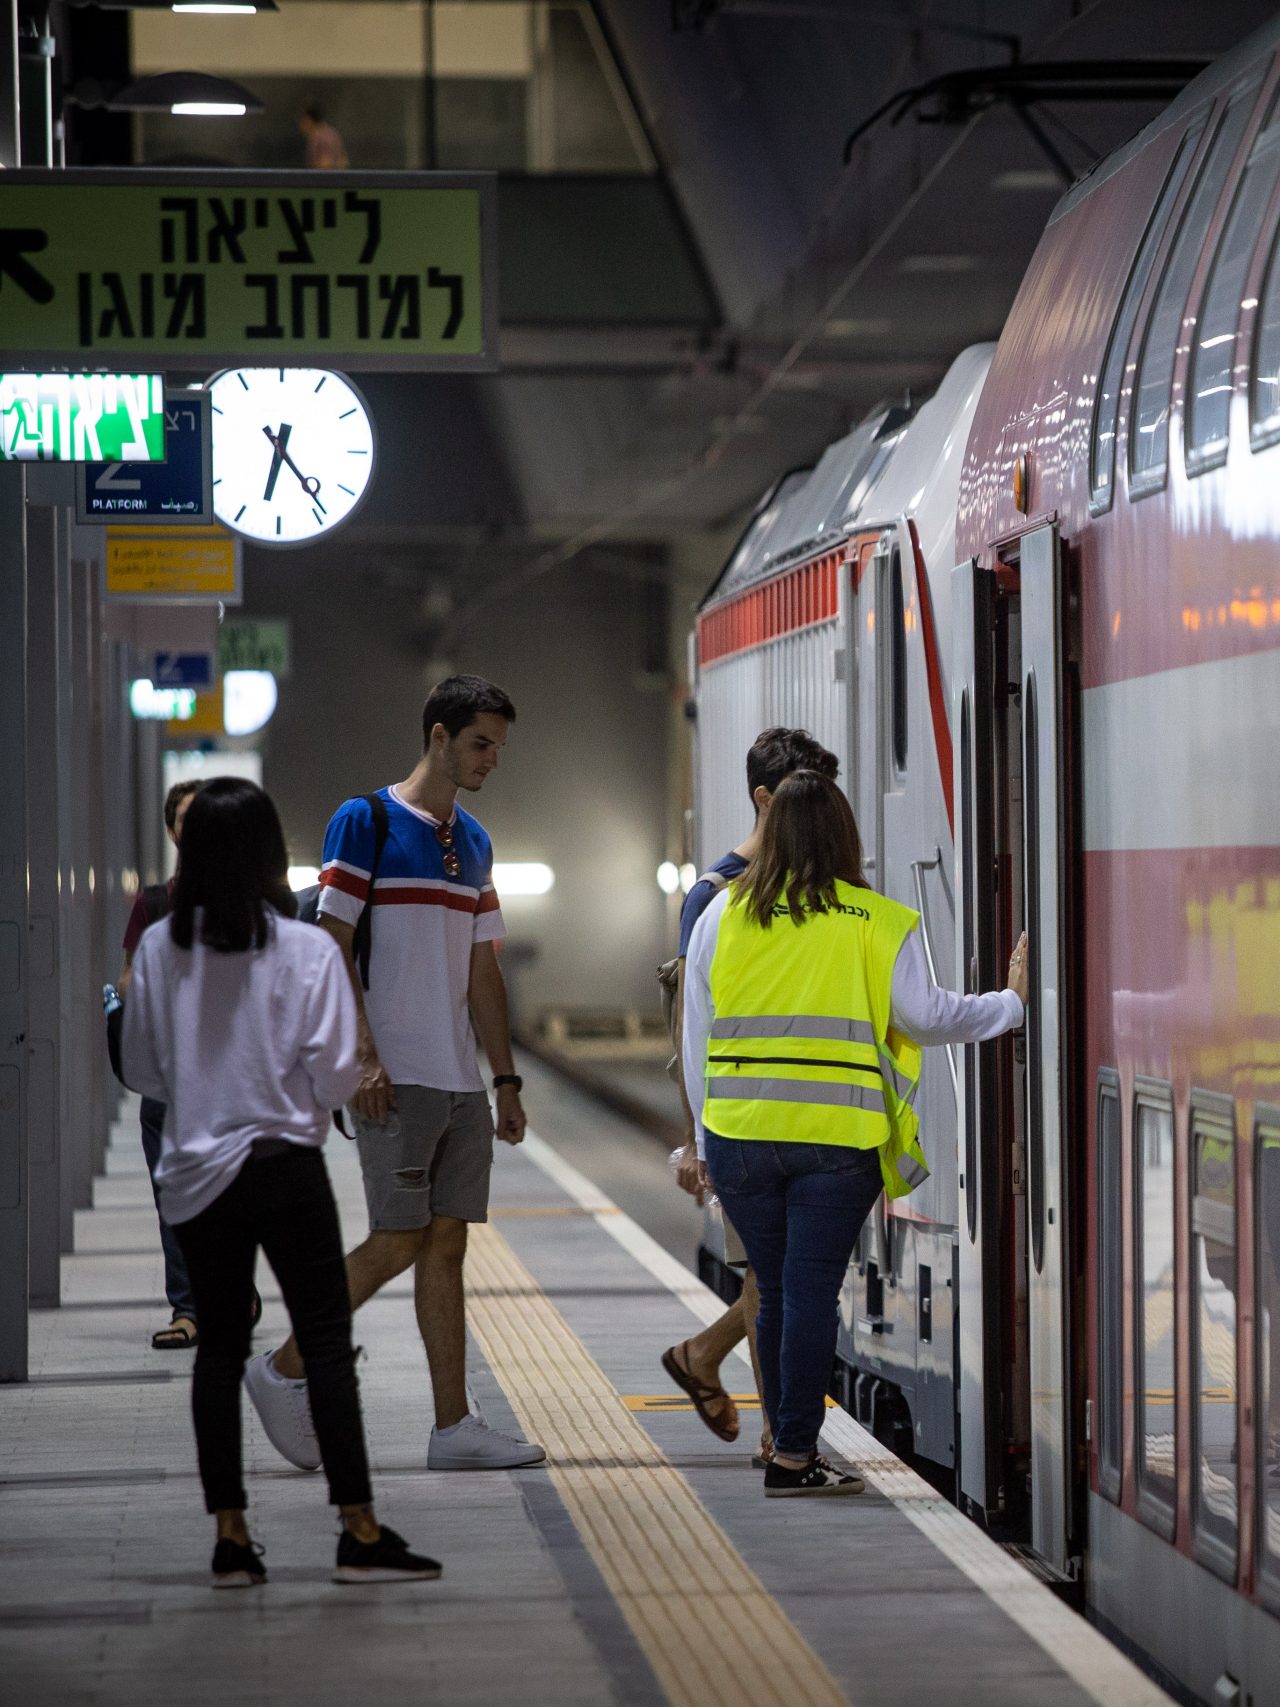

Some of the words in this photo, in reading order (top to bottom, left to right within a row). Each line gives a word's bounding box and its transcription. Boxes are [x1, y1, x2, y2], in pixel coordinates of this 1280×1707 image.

[161, 191, 381, 264] ליציאה
[77, 272, 206, 347] מוגן
[245, 267, 465, 340] למרחב
[92, 498, 148, 509] PLATFORM
